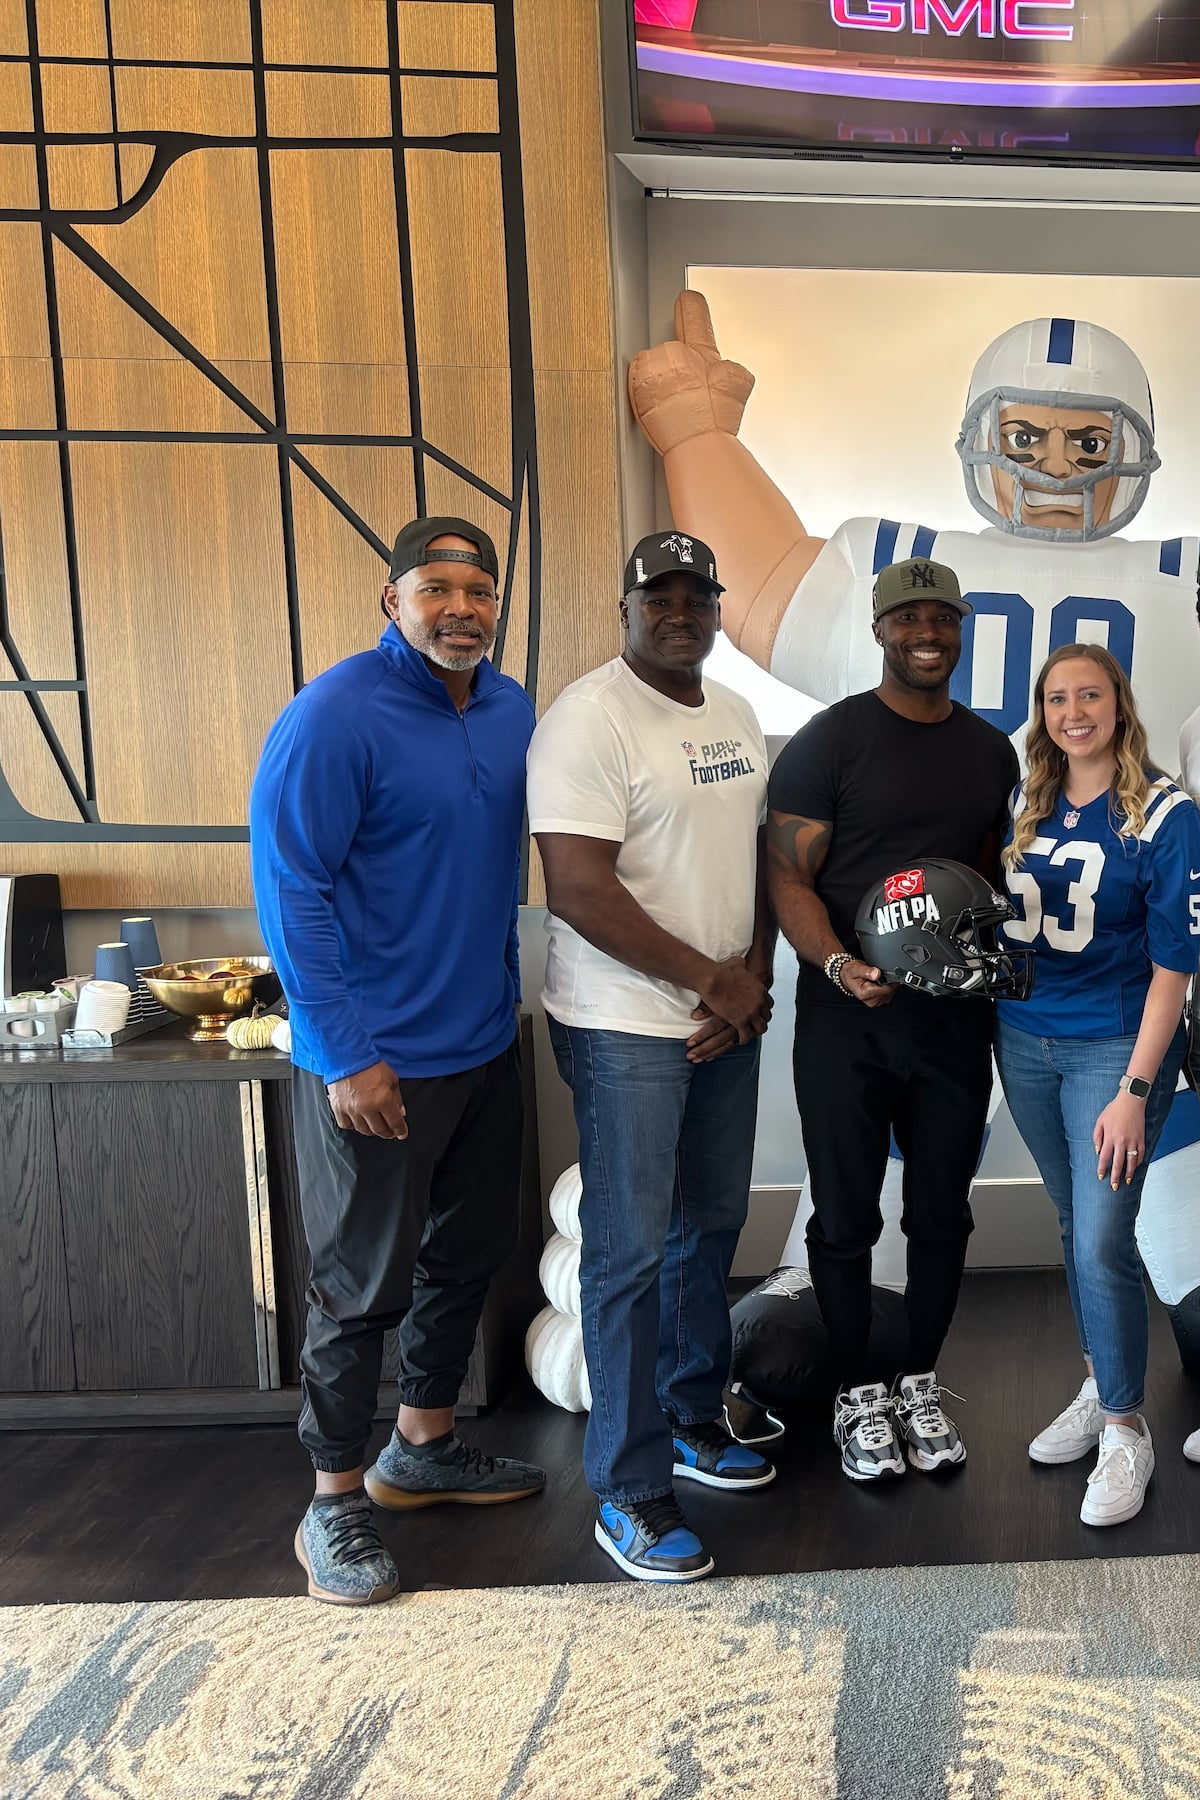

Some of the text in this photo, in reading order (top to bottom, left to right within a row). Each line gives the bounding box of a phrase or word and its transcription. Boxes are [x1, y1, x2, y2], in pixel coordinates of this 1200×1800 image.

[830, 0, 1074, 41] GMC
[910, 563, 936, 588] NY
[701, 740, 737, 763] PLAY
[689, 757, 755, 785] FOOTBALL
[1002, 836, 1106, 953] 53
[876, 894, 941, 936] NFLPA
